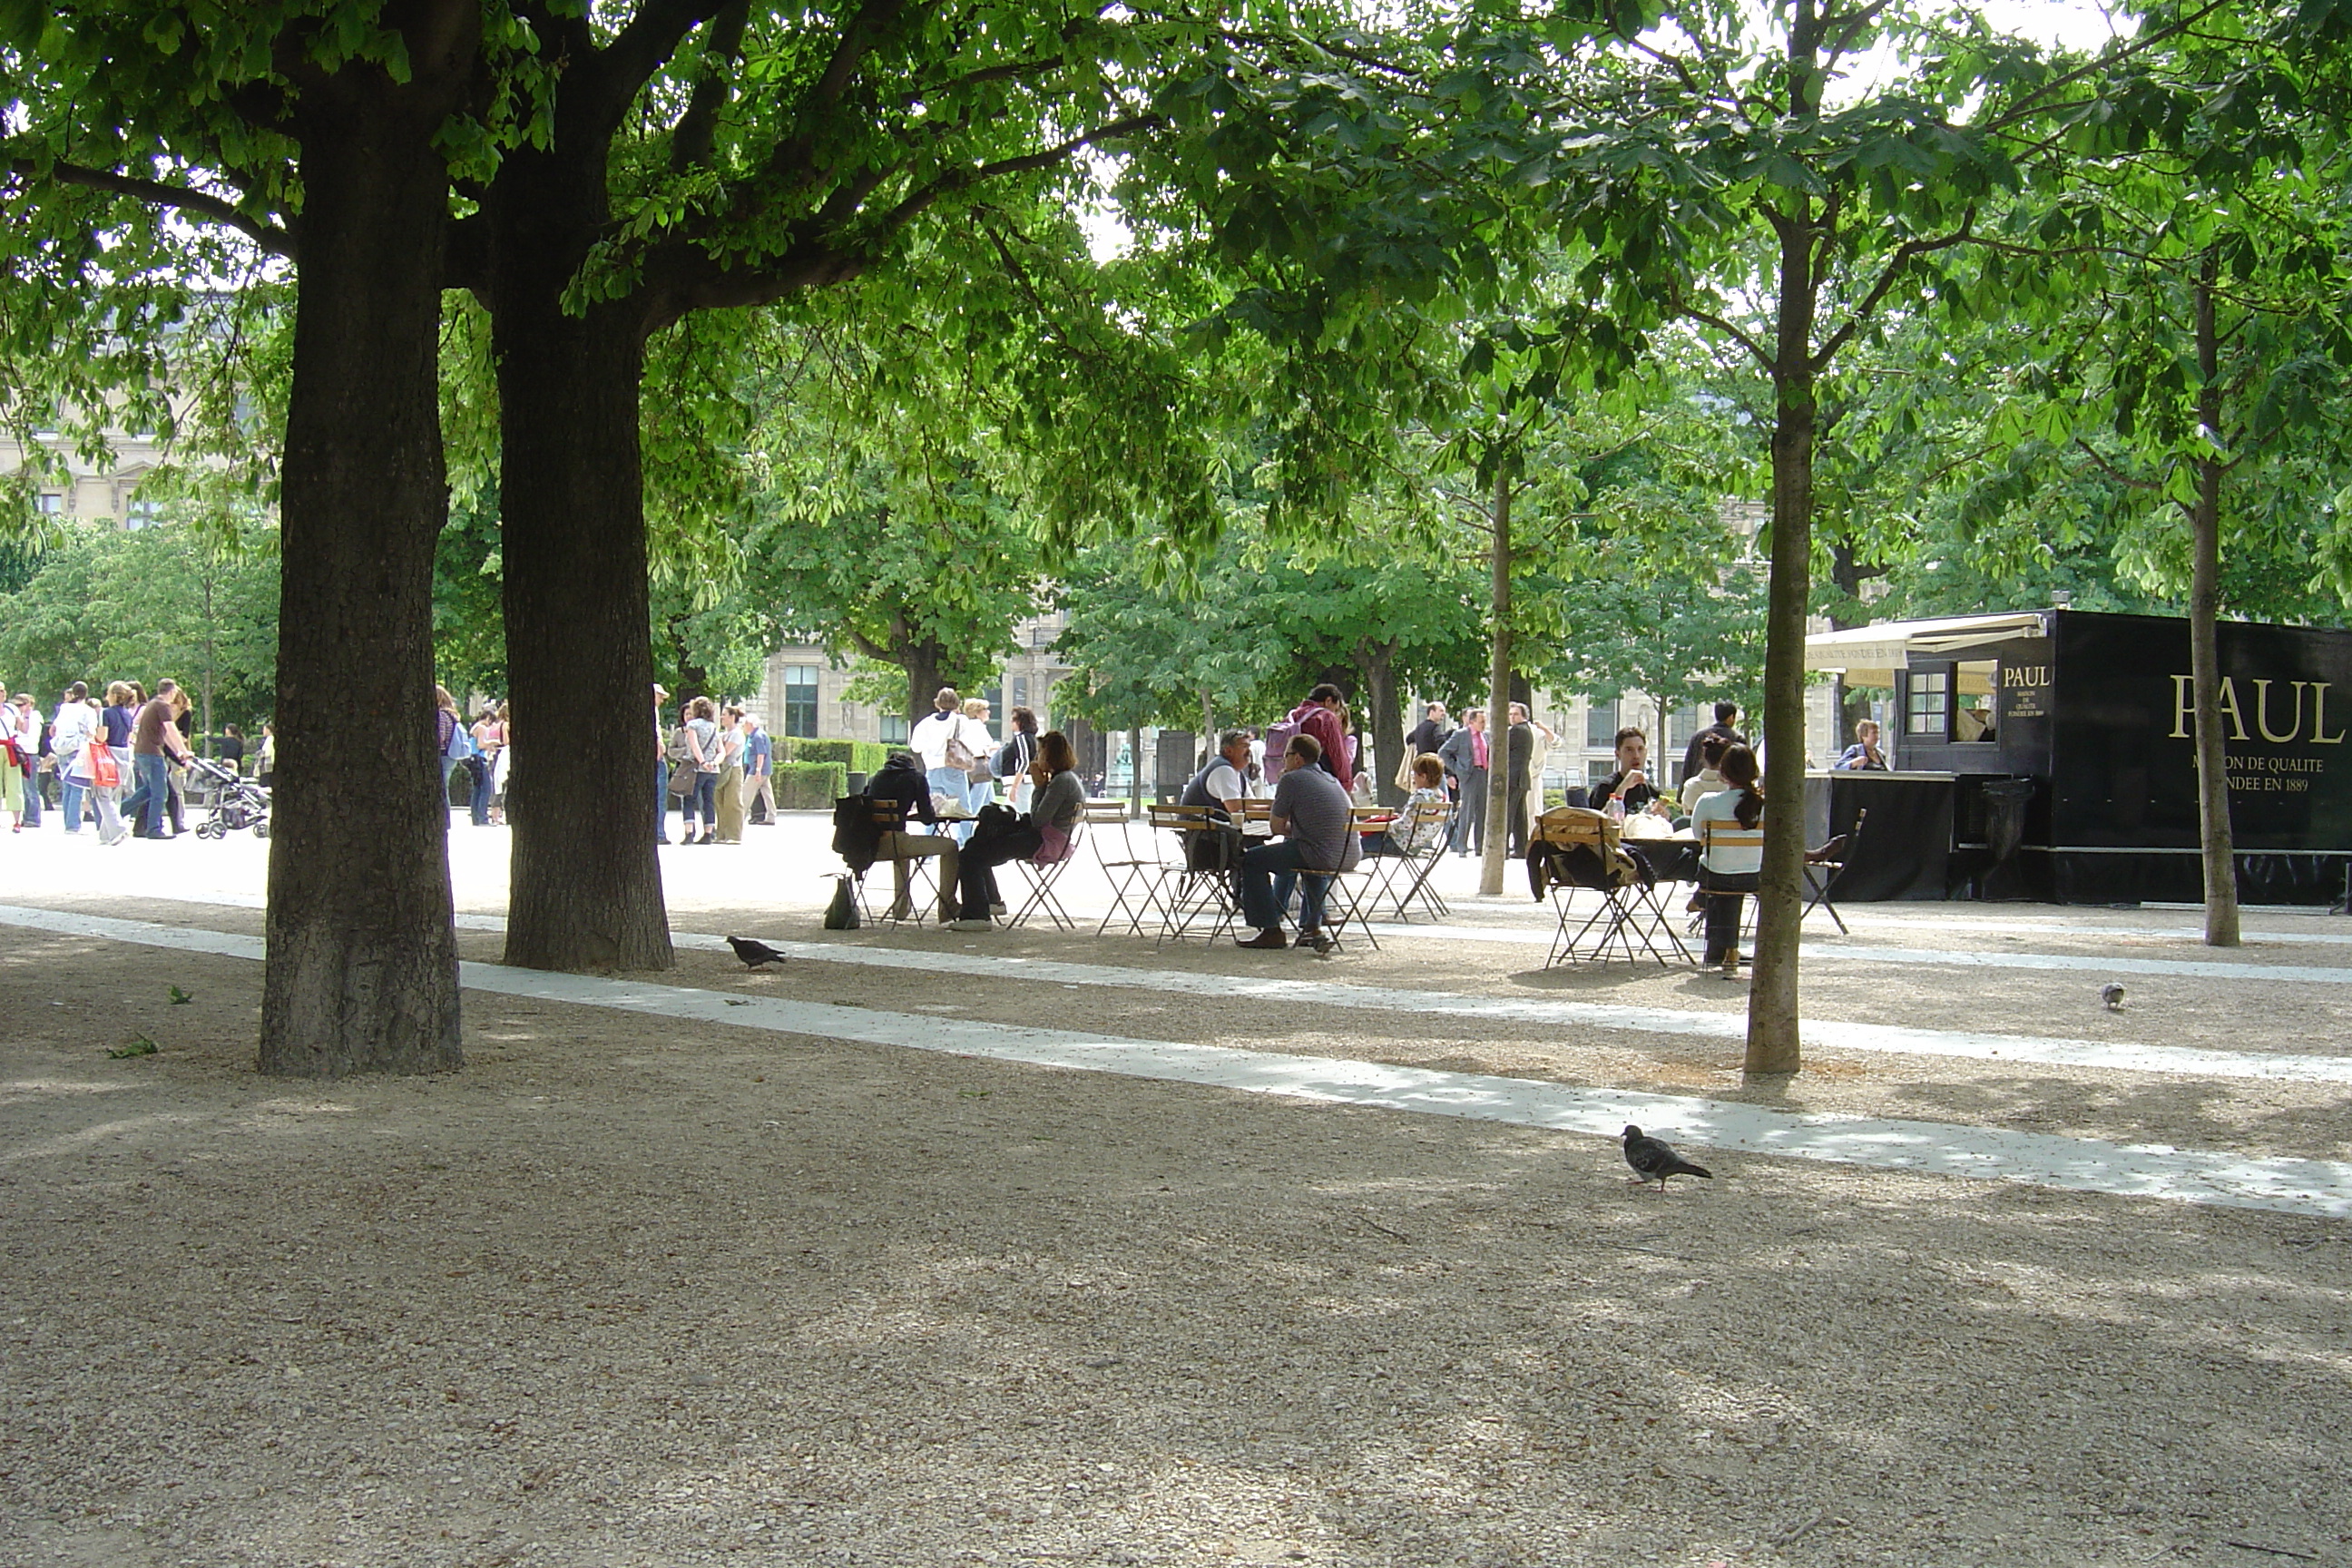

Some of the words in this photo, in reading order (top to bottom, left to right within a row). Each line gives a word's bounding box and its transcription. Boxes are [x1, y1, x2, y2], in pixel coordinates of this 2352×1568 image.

[2004, 666, 2050, 687] PAUL
[2168, 674, 2347, 744] PAUL
[2248, 756, 2265, 771] DE
[2268, 757, 2324, 774] QUALITE
[2264, 777, 2282, 792] EN
[2286, 778, 2308, 792] 1889
